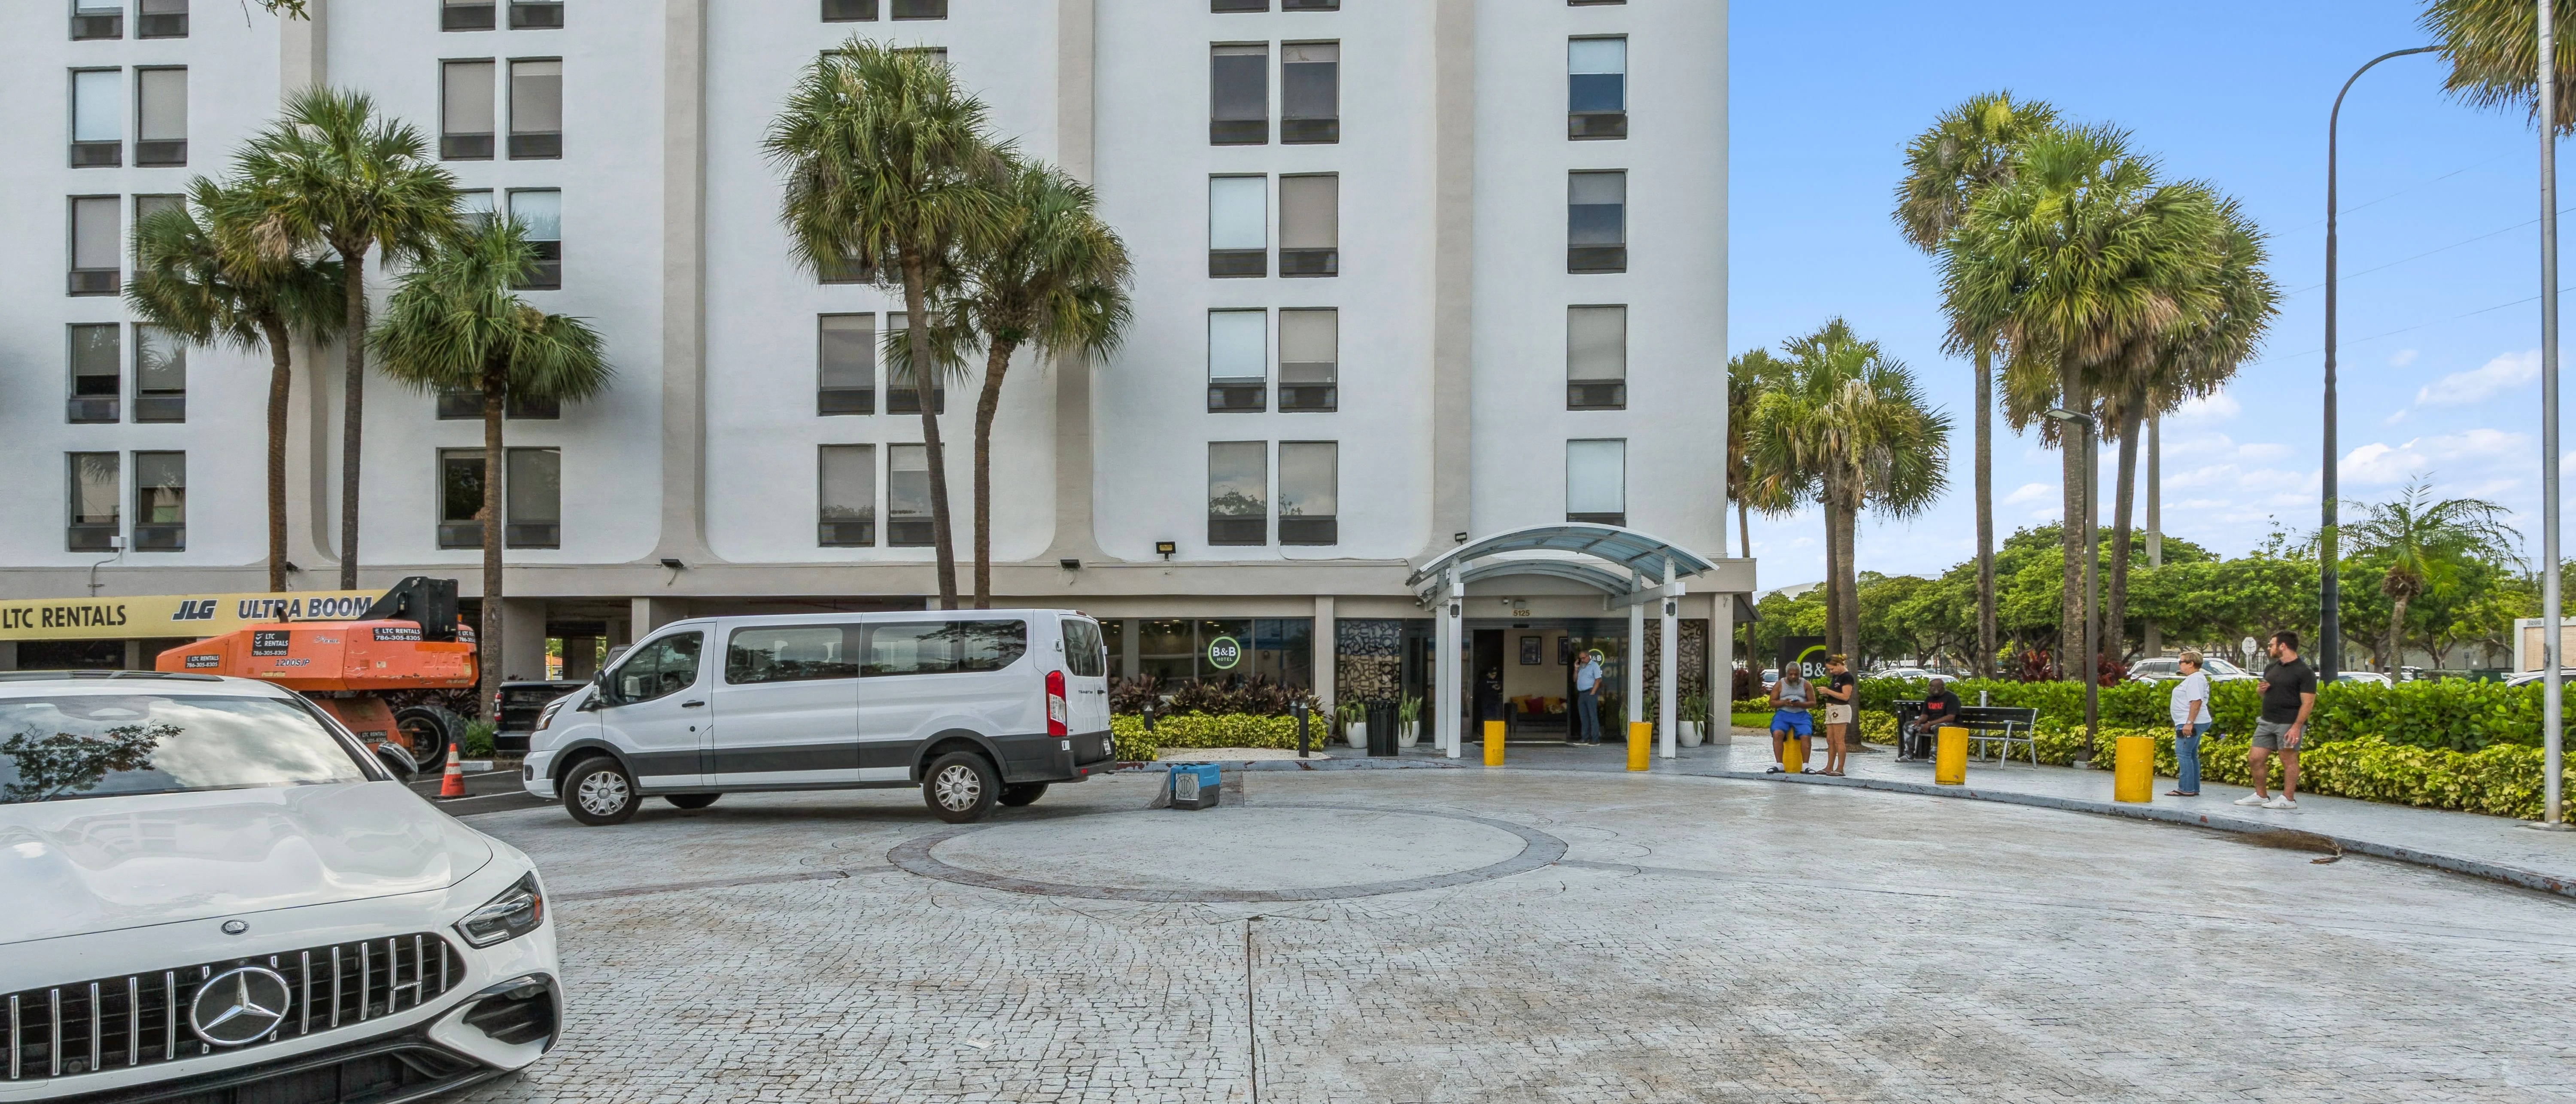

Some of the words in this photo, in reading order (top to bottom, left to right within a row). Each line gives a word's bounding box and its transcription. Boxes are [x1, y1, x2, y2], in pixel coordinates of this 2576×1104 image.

[3, 608, 33, 629] LTC
[42, 605, 126, 628] RENTALS
[171, 599, 218, 621] JLG
[238, 598, 302, 619] ULTRA
[307, 596, 373, 618] BOOM
[424, 652, 461, 668] JLG
[1213, 647, 1236, 657] B&B
[1803, 662, 1826, 677] B&
